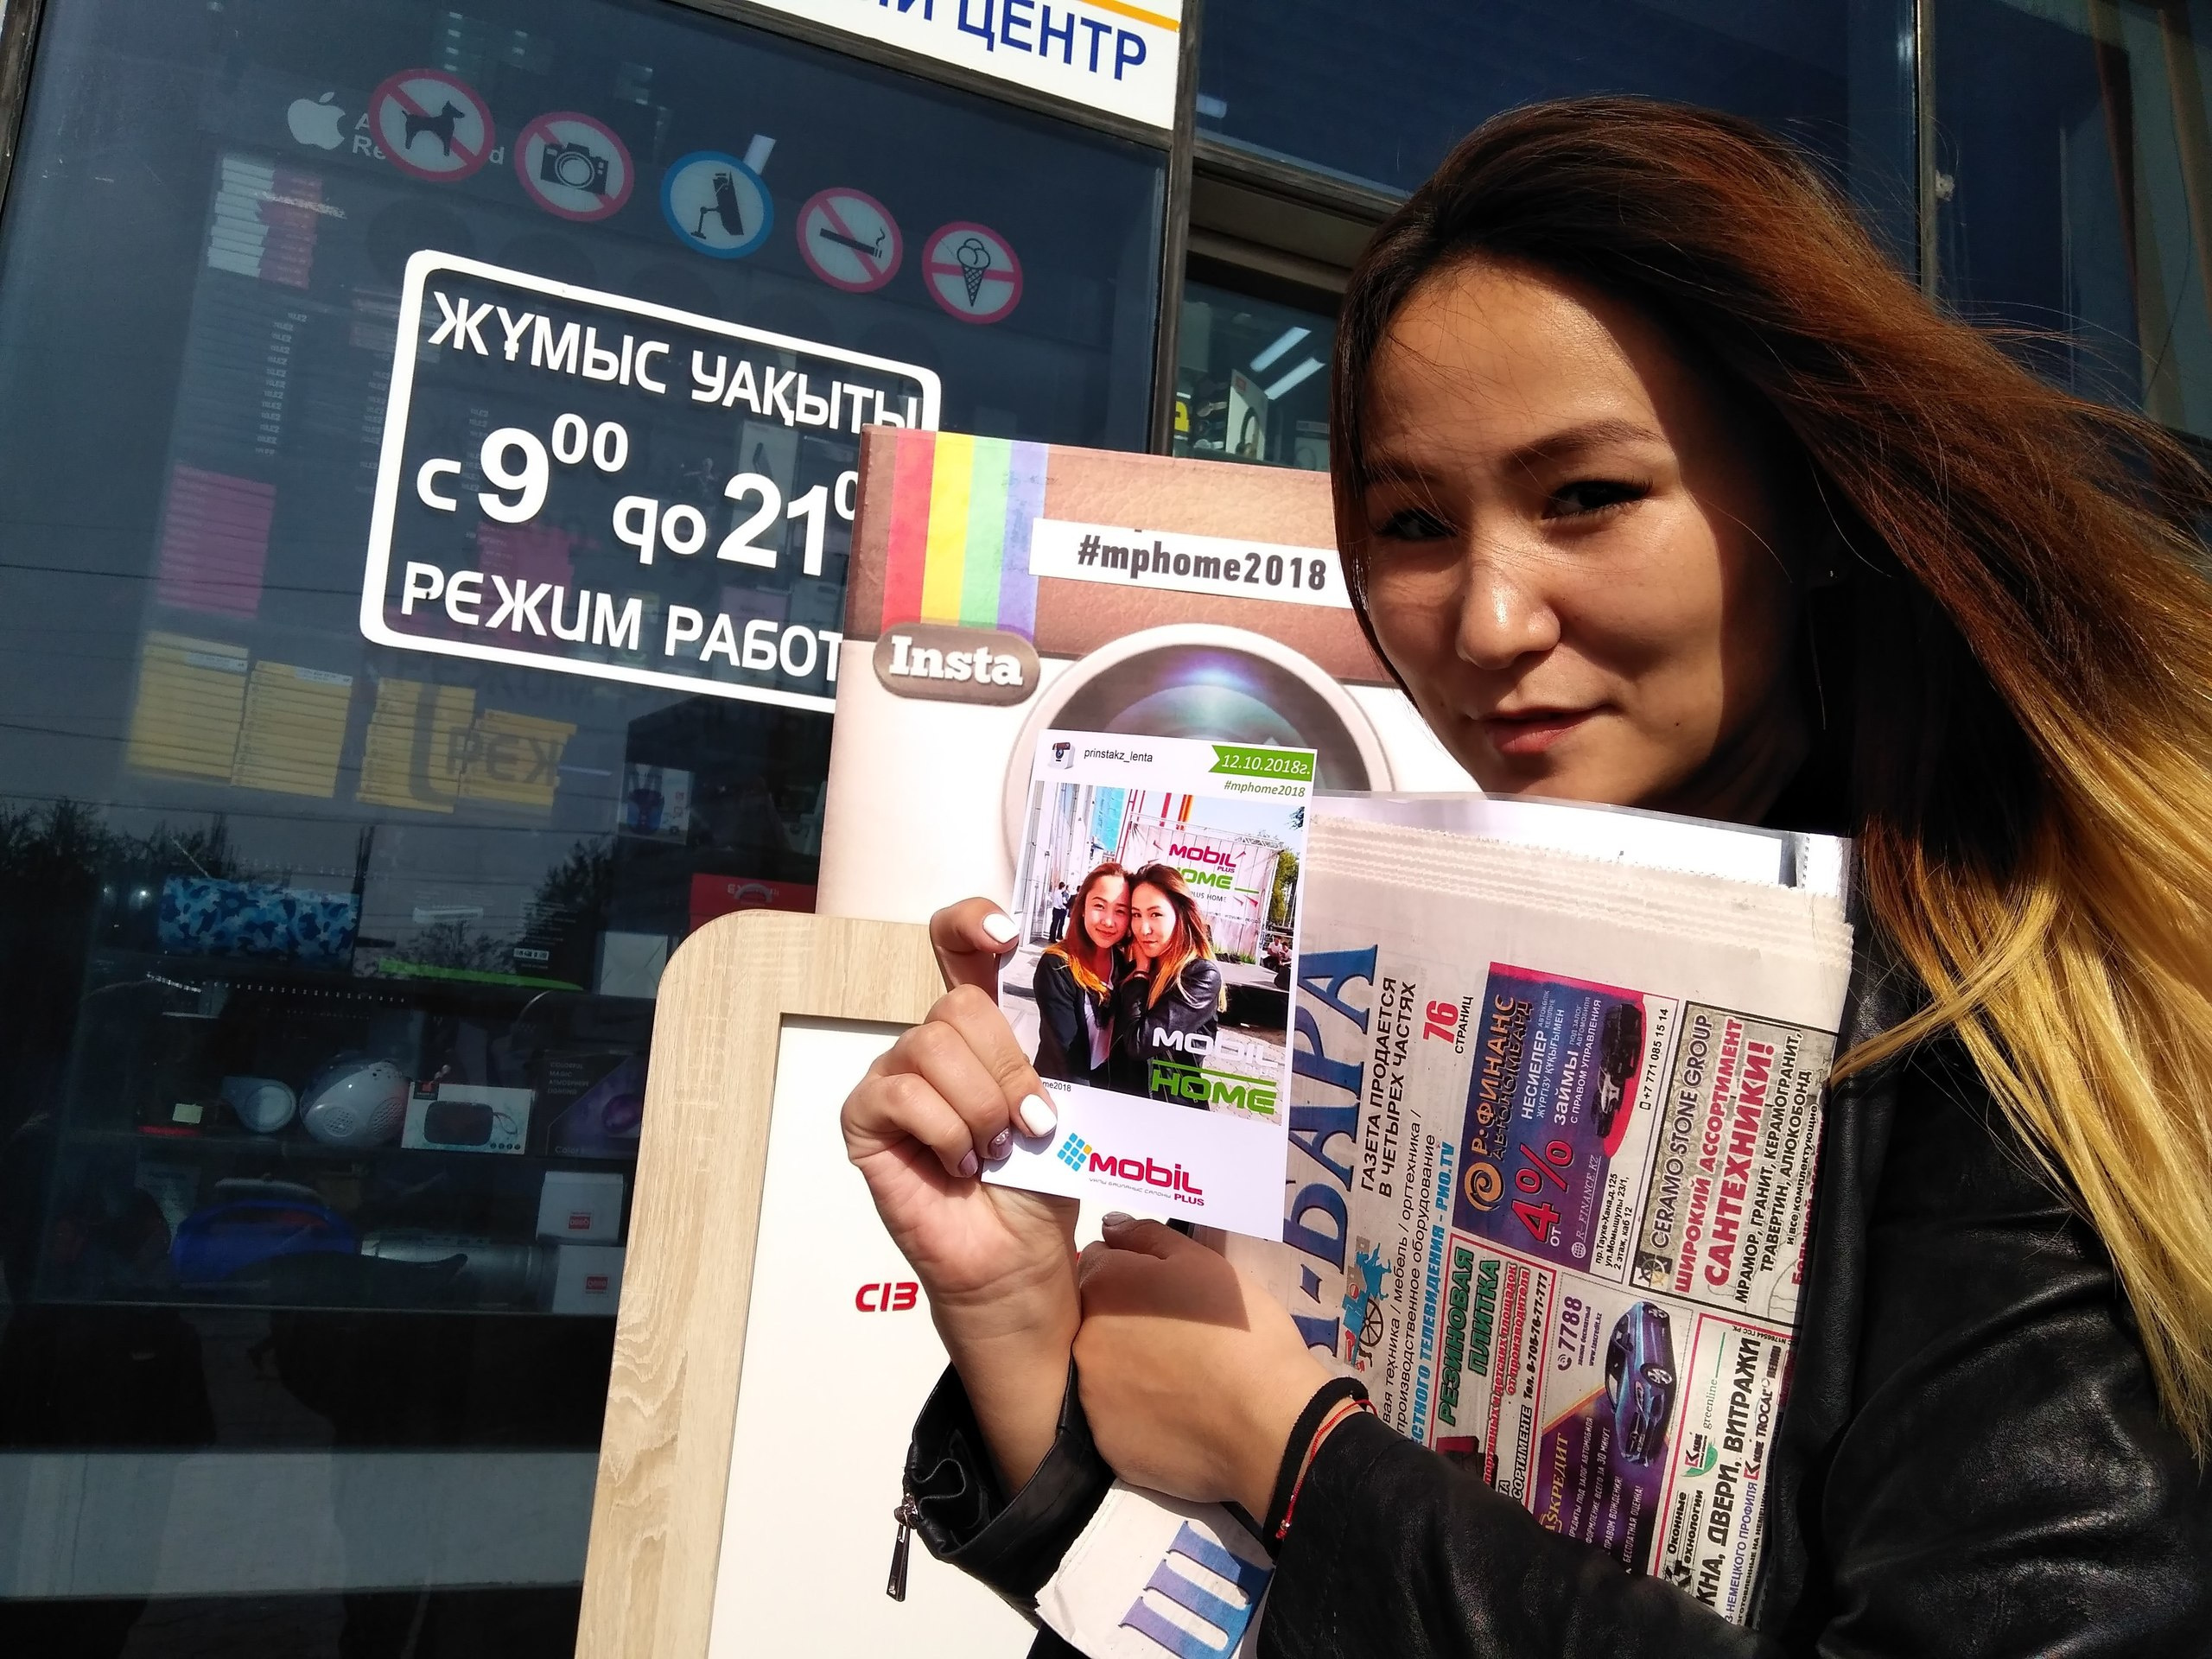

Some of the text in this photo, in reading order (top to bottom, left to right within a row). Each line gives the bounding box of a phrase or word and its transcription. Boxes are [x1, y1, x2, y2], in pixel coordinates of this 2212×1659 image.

[957, 0, 1147, 81] ЦЕНТР
[690, 350, 923, 434] УАҚЫТЫ
[1077, 534, 1325, 591] #mphome2018
[400, 562, 642, 651] РЕЖИМ
[889, 635, 1023, 686] Insta
[1084, 747, 1153, 763] prinstakz_lenta
[1224, 780, 1306, 798] #mphome2018
[1422, 999, 1459, 1046] 76
[1454, 995, 1472, 1054] СТРАНИЦ
[1572, 1070, 1587, 1114] ПРАВОМ
[1580, 999, 1601, 1068] УПРАВЛЕНИЯ
[1643, 1007, 1669, 1100] +7 771 085 15 14
[1151, 1070, 1276, 1115] HOME
[1360, 977, 1396, 1191] ГАЗЕТА ПРОДАЕТСЯ
[1378, 981, 1415, 1197] В ЧЕТЫРЕХ ЧАСТЯХ
[1521, 1029, 1548, 1120] НЕСИЕЛЕР
[1536, 1076, 1551, 1118] ЖҮРГІЗУ
[1649, 1013, 1713, 1249] CERAMO STONE GROUP
[1674, 1018, 1743, 1294] ШИРОКИЙ АССОРТИМЕНТ
[1703, 1040, 1775, 1288] САНТЕХНИКИ!
[1792, 1104, 1819, 1211] комплектующие
[1174, 1193, 1205, 1206] PLUS
[1401, 1122, 1421, 1221] оргтехника
[1507, 1129, 1576, 1247] ОТ 4%
[1734, 1030, 1802, 1304] МРАМОР, ГРАНИТ, КЕРАМОГРАНИТ,
[1760, 1069, 1812, 1274] ТРАВЕРТИН, АЛЮКОБОНД
[1605, 1174, 1629, 1267] ул.Момышулы 23/1,
[1620, 1218, 1630, 1236] каб
[1624, 1206, 1632, 1217] 12
[1785, 1236, 1795, 1244] и
[1788, 1212, 1799, 1234] все
[1392, 1235, 1408, 1302] мебель
[1419, 1224, 1446, 1362] ТЕЛЕВИДЕНИЯ
[1434, 1141, 1455, 1211] РИО.TV
[1616, 1237, 1627, 1262] этаж,
[1395, 1134, 1436, 1434] производственное оборудование
[1467, 1255, 1500, 1376] ПЛИТКА
[1498, 1262, 1518, 1337] площадок
[1386, 1317, 1400, 1387] техника
[1436, 1245, 1473, 1427] РЕЗИНОВАЯ
[1505, 1268, 1531, 1395] от производителя
[1556, 1294, 1583, 1353] 7788
[1577, 1305, 1592, 1365] звонок бесплатный
[1491, 1334, 1508, 1395] детских
[1723, 1336, 1761, 1453] ВИТРАЖИ
[1491, 1394, 1501, 1406] и
[1702, 1377, 1717, 1430] greenline
[1581, 1416, 1593, 1464] АВТОМОБИЛЯ
[1596, 1452, 1606, 1465] 30
[1597, 1465, 1604, 1475] ЗА
[1599, 1427, 1611, 1452] МИНУТ
[1575, 1488, 1585, 1504] ПОД
[1578, 1465, 1588, 1487] ЗАЛОГ
[1593, 1476, 1604, 1498] ВСЕГО
[1706, 1456, 1742, 1547] ДВЕРИ,
[1603, 1475, 1624, 1549] ПРАВОМ ВОЖДЕНИЯ!
[1622, 1484, 1643, 1563] БЕСПЛАТНАЯ ОЦЕНКА!
[1668, 1491, 1687, 1555] Оконные
[1751, 1535, 1759, 1550] НА
[1725, 1540, 1747, 1613] НЕМЕЦКОГО
[1738, 1481, 1758, 1539] ПРОФИЛЯ
